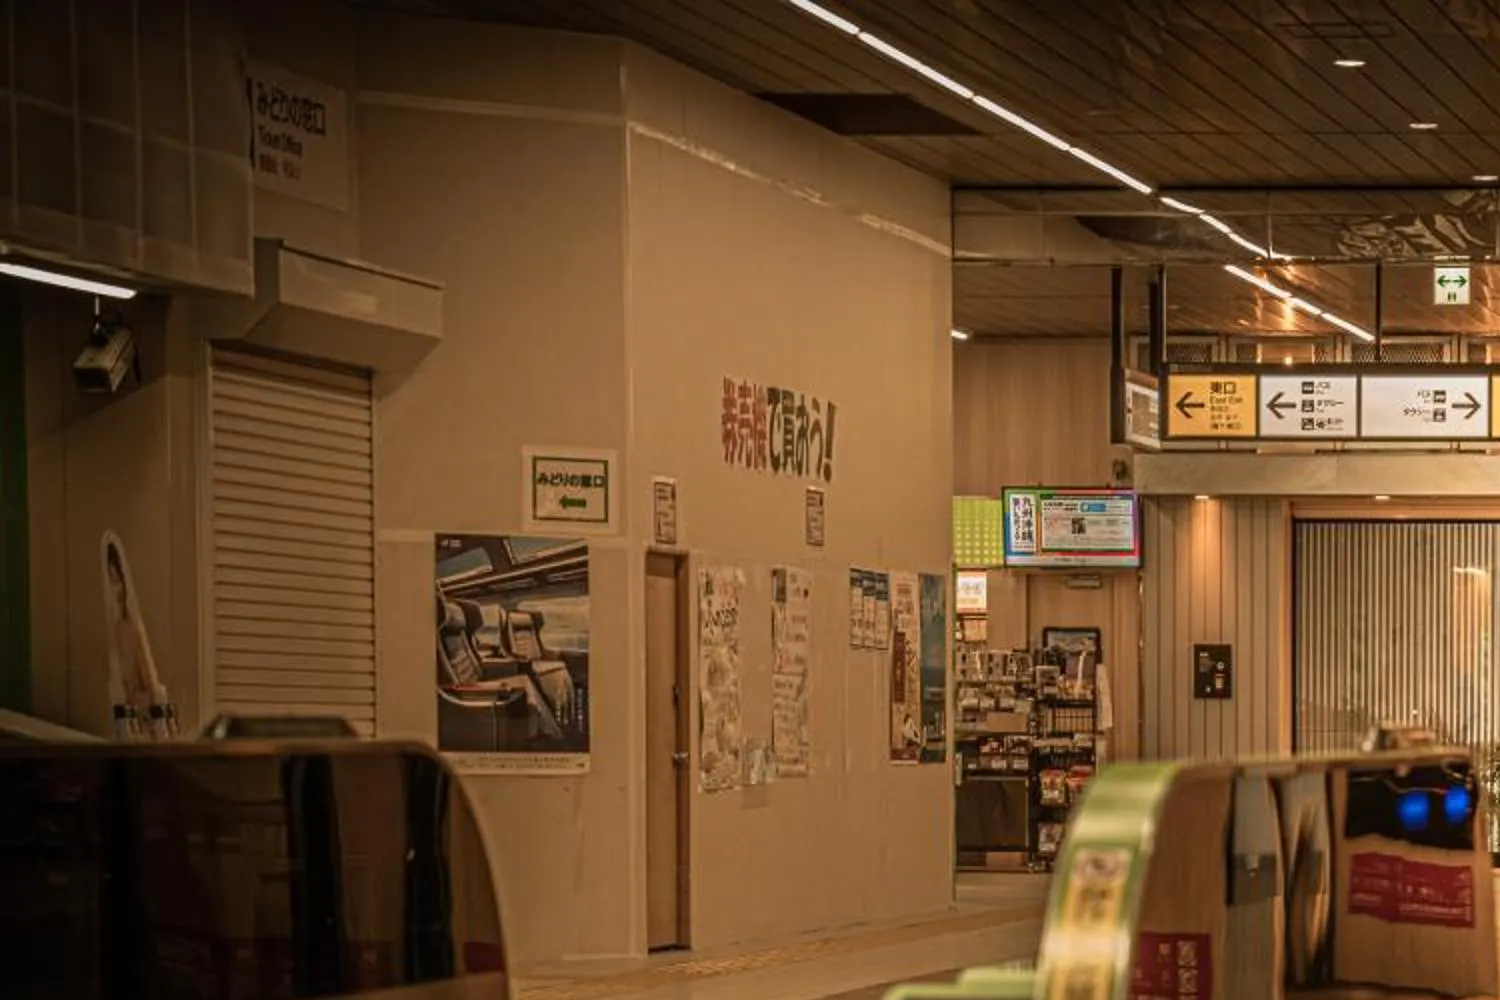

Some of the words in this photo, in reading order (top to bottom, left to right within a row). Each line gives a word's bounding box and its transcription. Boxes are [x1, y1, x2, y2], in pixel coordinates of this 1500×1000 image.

[1210, 381, 1237, 395] 東口
[537, 472, 604, 488] みどりの窓口
